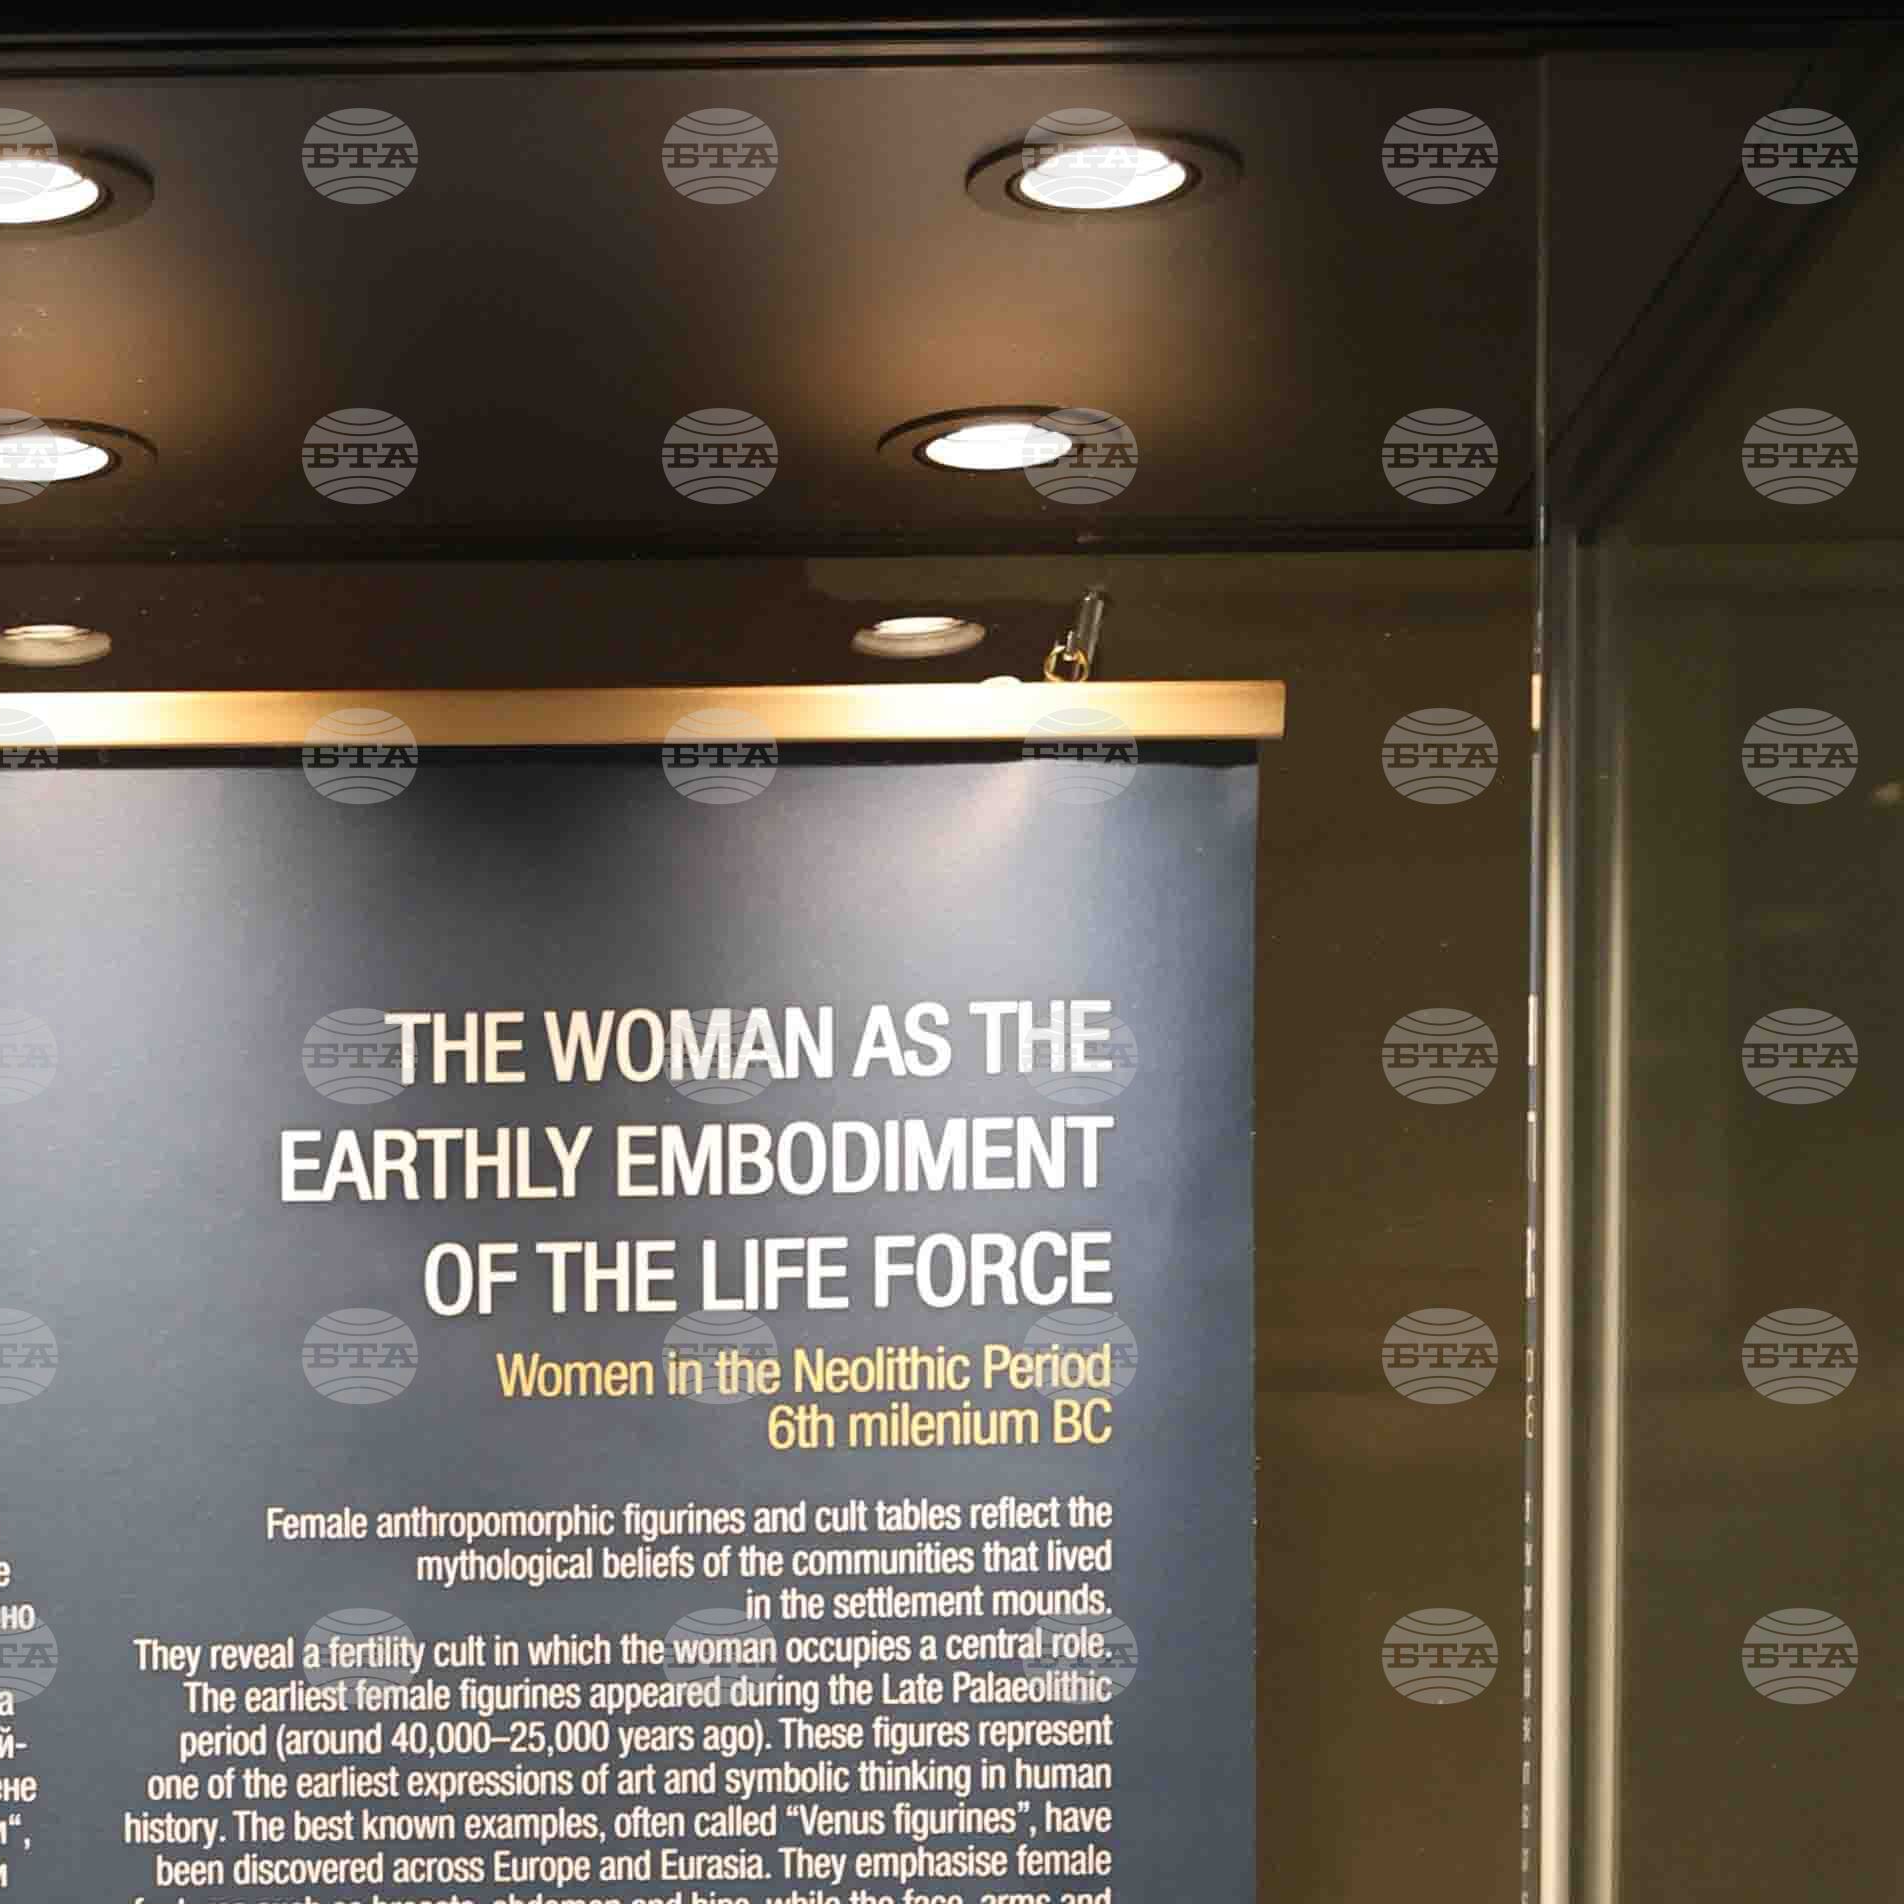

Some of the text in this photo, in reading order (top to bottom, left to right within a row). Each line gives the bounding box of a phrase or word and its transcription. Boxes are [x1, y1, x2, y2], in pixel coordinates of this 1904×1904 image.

[383, 1000, 1113, 1086] THE WOMAN AS THE
[280, 1115, 1115, 1202] EARTHLY EMBODIMENT
[424, 1230, 1114, 1317] OF THE LIFE FORCE
[495, 1342, 1112, 1398] Women in the Neolithic Period
[767, 1396, 1113, 1450] 6th milenium BC
[266, 1496, 1113, 1543] Female anthropomorphic figurines and cult tables reflect the
[124, 1800, 1113, 1849] history. The best known examples, often called “Venus figurines”, have
